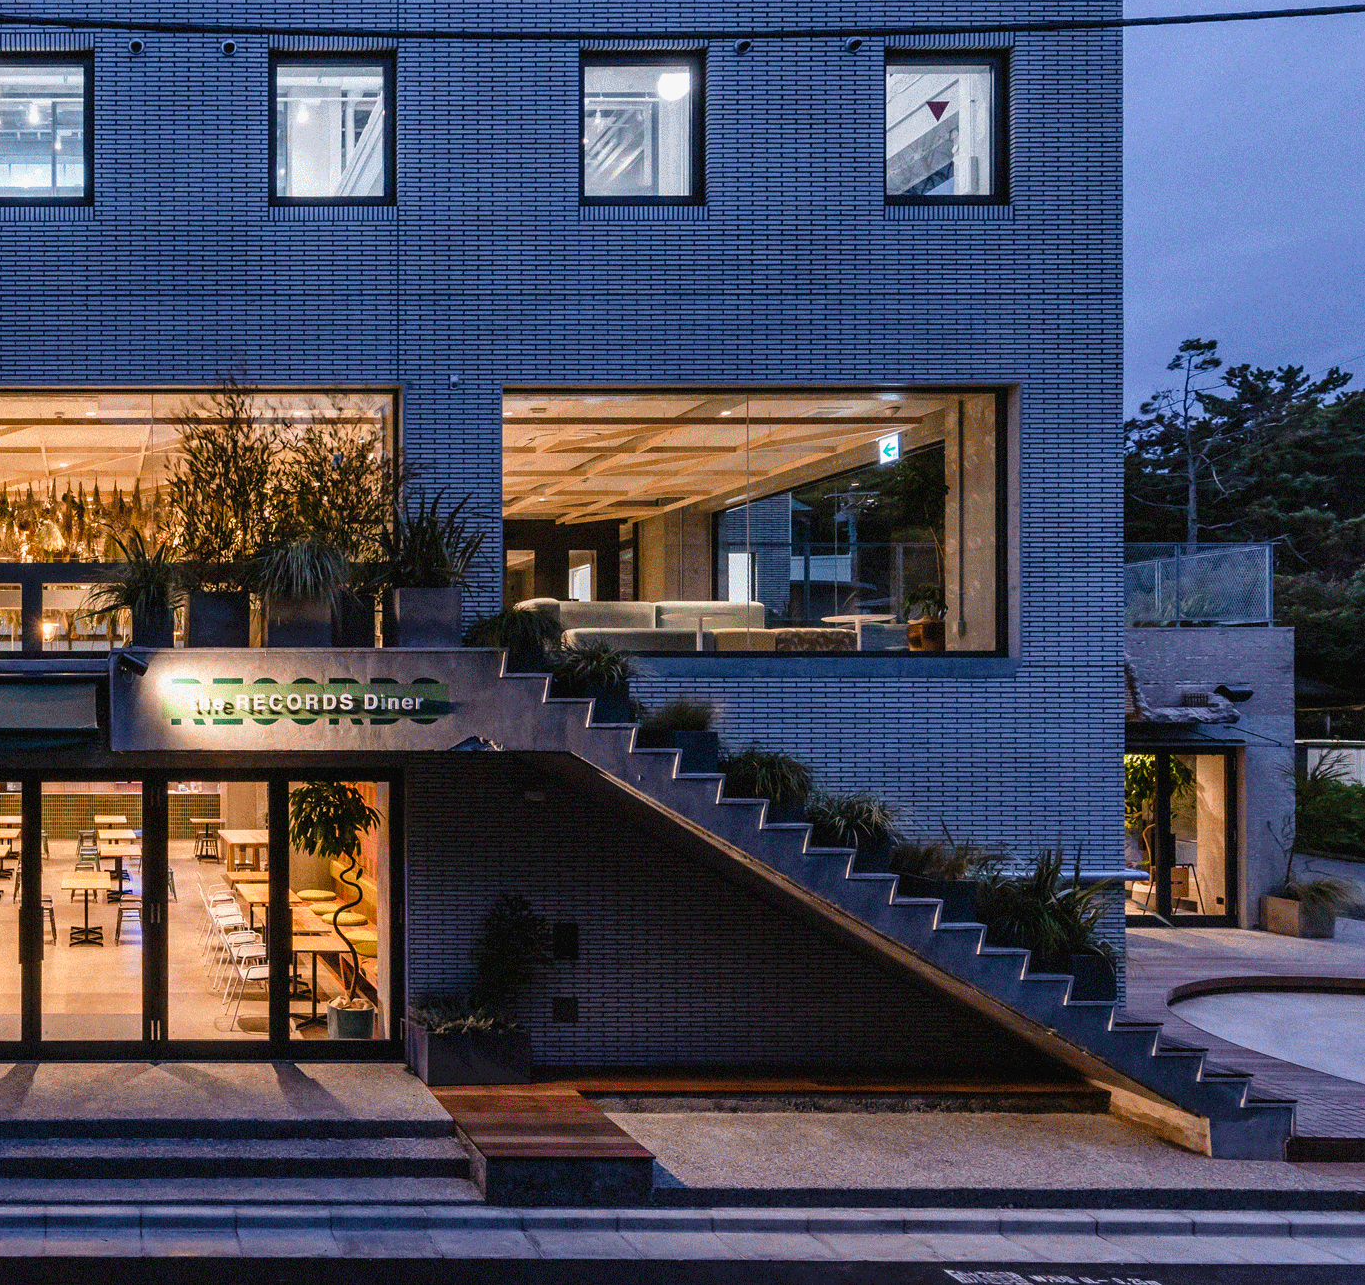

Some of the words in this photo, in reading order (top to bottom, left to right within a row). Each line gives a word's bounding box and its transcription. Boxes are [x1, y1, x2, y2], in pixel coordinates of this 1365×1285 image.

[189, 693, 225, 711] the
[235, 693, 354, 711] RECORDS
[364, 693, 424, 711] Diner
